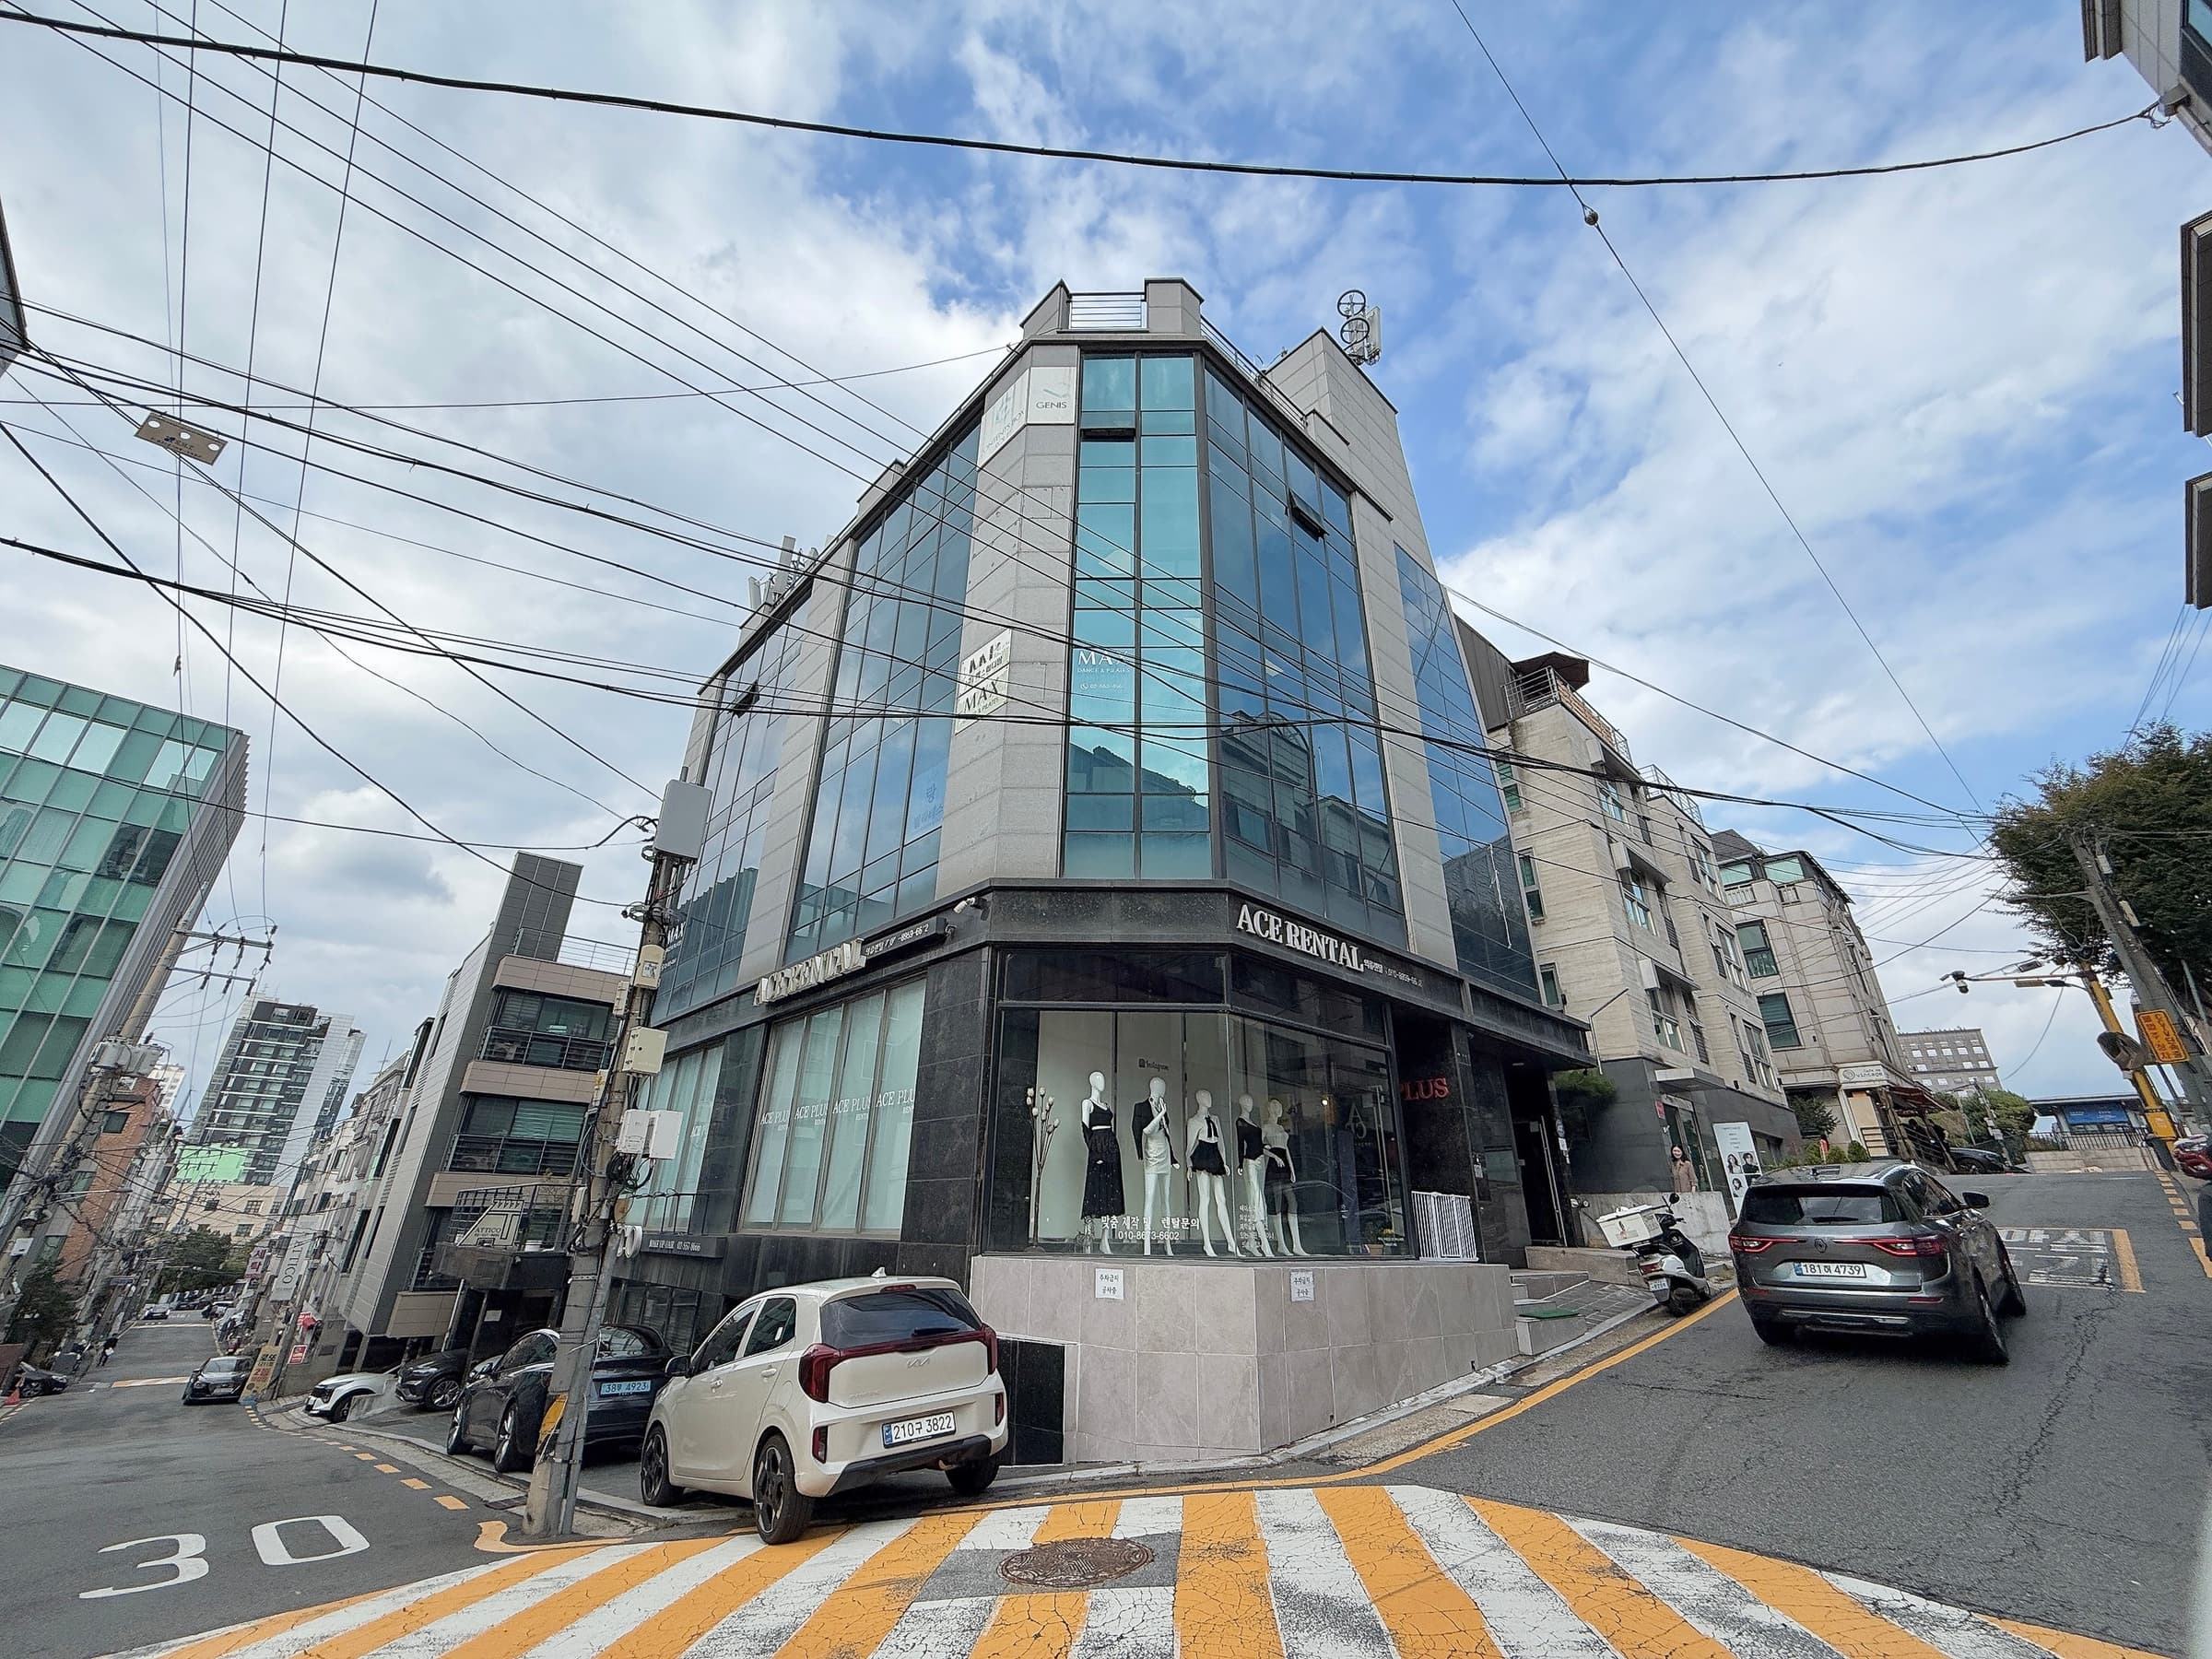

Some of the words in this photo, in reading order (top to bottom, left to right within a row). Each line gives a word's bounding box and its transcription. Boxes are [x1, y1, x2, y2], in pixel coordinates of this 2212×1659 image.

[1036, 401, 1067, 409] GENIS
[1236, 904, 1284, 944] ACE
[1285, 921, 1364, 972] RENTAL
[877, 1091, 895, 1107] ACE
[898, 1088, 914, 1105] PLU
[794, 1106, 809, 1120] ACE
[832, 1099, 849, 1113] ACE
[760, 1112, 774, 1125] ACE
[774, 1109, 790, 1123] PLU
[1101, 1215, 1119, 1230] 맞춤
[1122, 1216, 1139, 1230] 제작
[1161, 1216, 1200, 1230] 렌탈문의
[1803, 1264, 1831, 1274] 181허
[1834, 1265, 1861, 1275] 4739
[893, 1422, 923, 1440] 210구
[926, 1415, 952, 1433] 3822
[79, 1514, 371, 1599] 30
